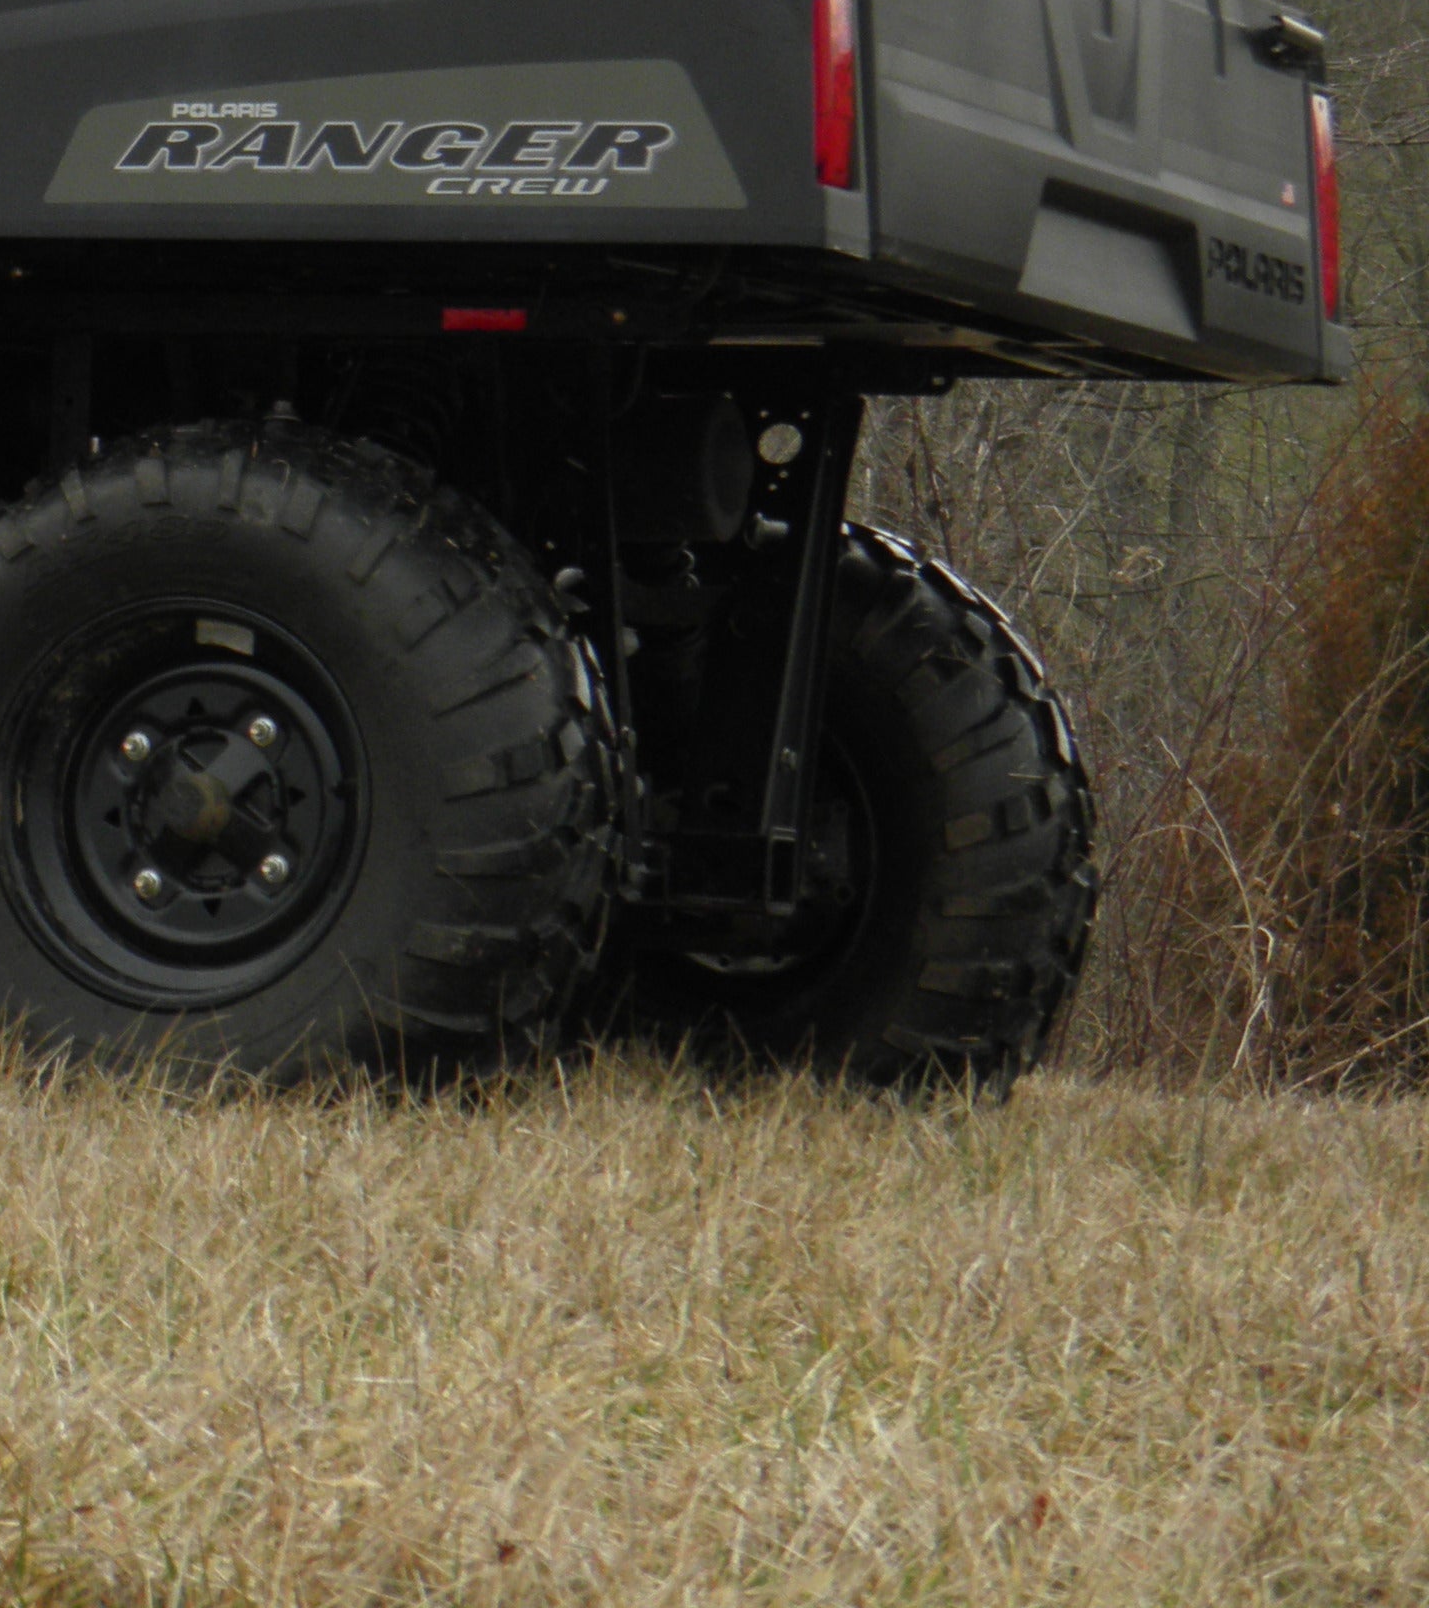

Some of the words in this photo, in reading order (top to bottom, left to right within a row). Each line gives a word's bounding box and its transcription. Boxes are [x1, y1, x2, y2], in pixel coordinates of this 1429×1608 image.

[172, 102, 279, 119] POLARIS
[114, 121, 677, 171] RANGER
[426, 177, 609, 195] CREW
[1205, 236, 1305, 306] POLARIS
